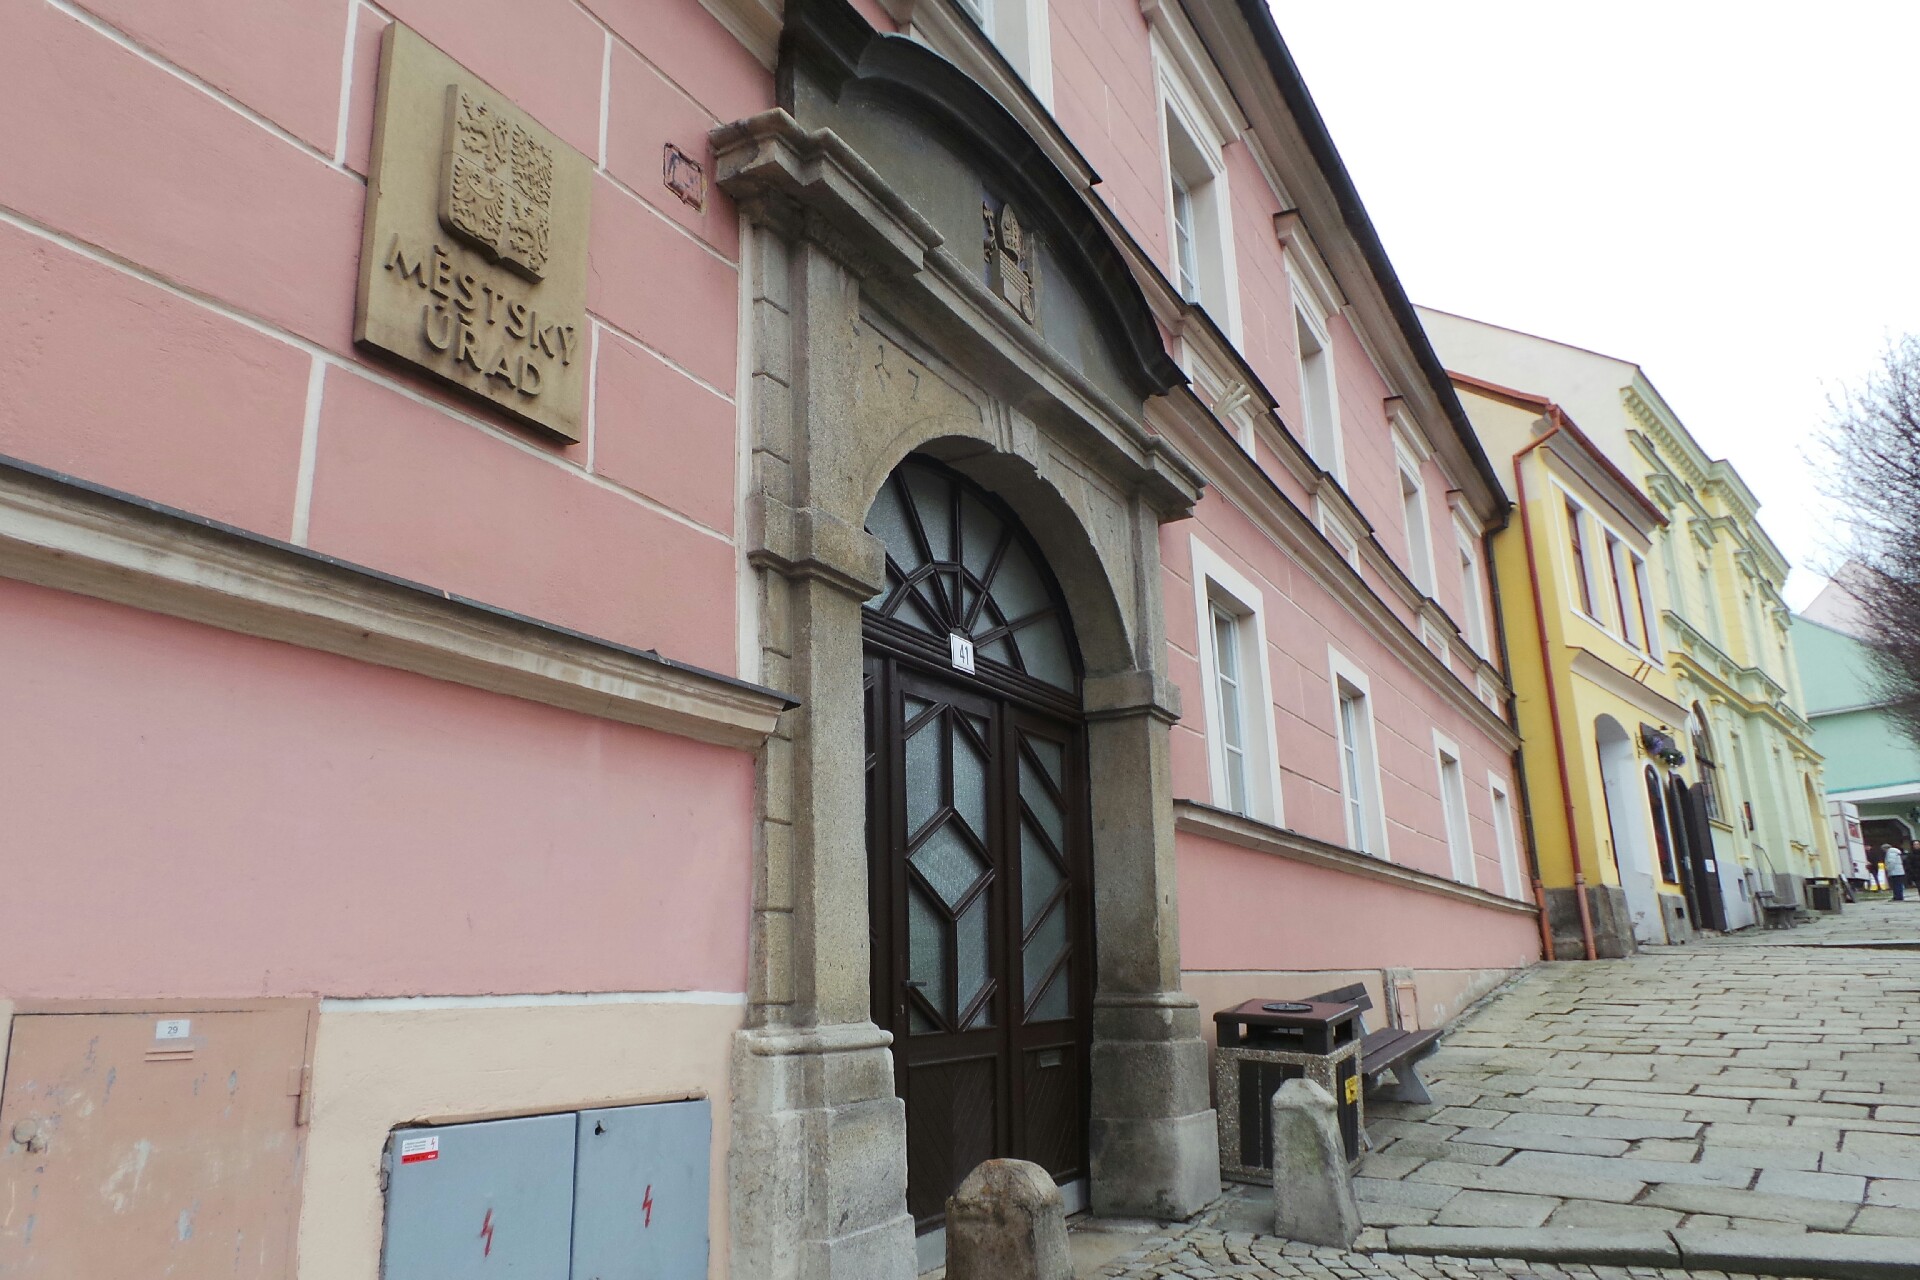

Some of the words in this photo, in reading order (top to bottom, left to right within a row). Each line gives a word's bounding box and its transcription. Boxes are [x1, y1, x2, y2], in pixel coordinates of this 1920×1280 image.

[384, 232, 577, 367] MĚSTSKÝ
[422, 301, 543, 397] ÚŘAD
[959, 644, 969, 666] 41
[167, 1025, 179, 1035] 29
